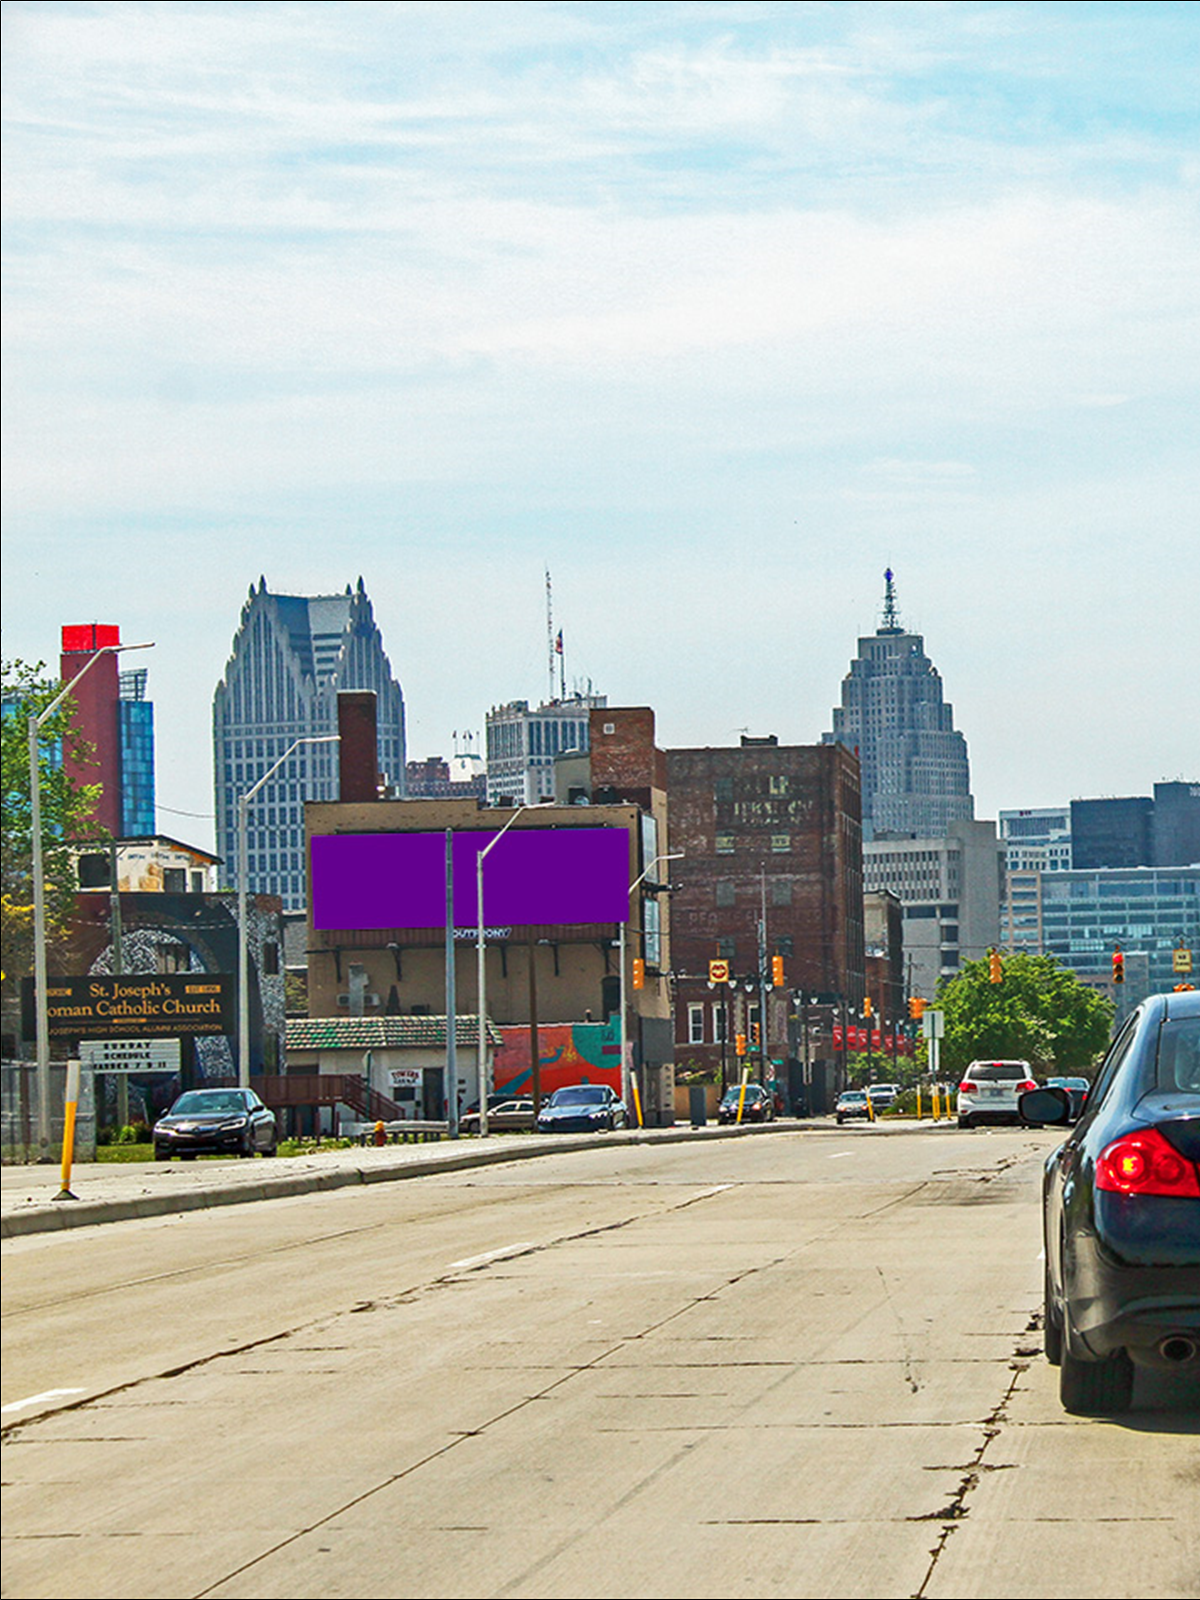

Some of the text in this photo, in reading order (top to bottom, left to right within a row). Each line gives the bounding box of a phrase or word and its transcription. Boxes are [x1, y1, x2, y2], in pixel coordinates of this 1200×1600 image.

[89, 982, 171, 1000] St. Joseph's
[47, 998, 221, 1018] oman Catholic Church
[103, 1042, 151, 1050] SUNDAY
[104, 1052, 151, 1060] SCHEDULE
